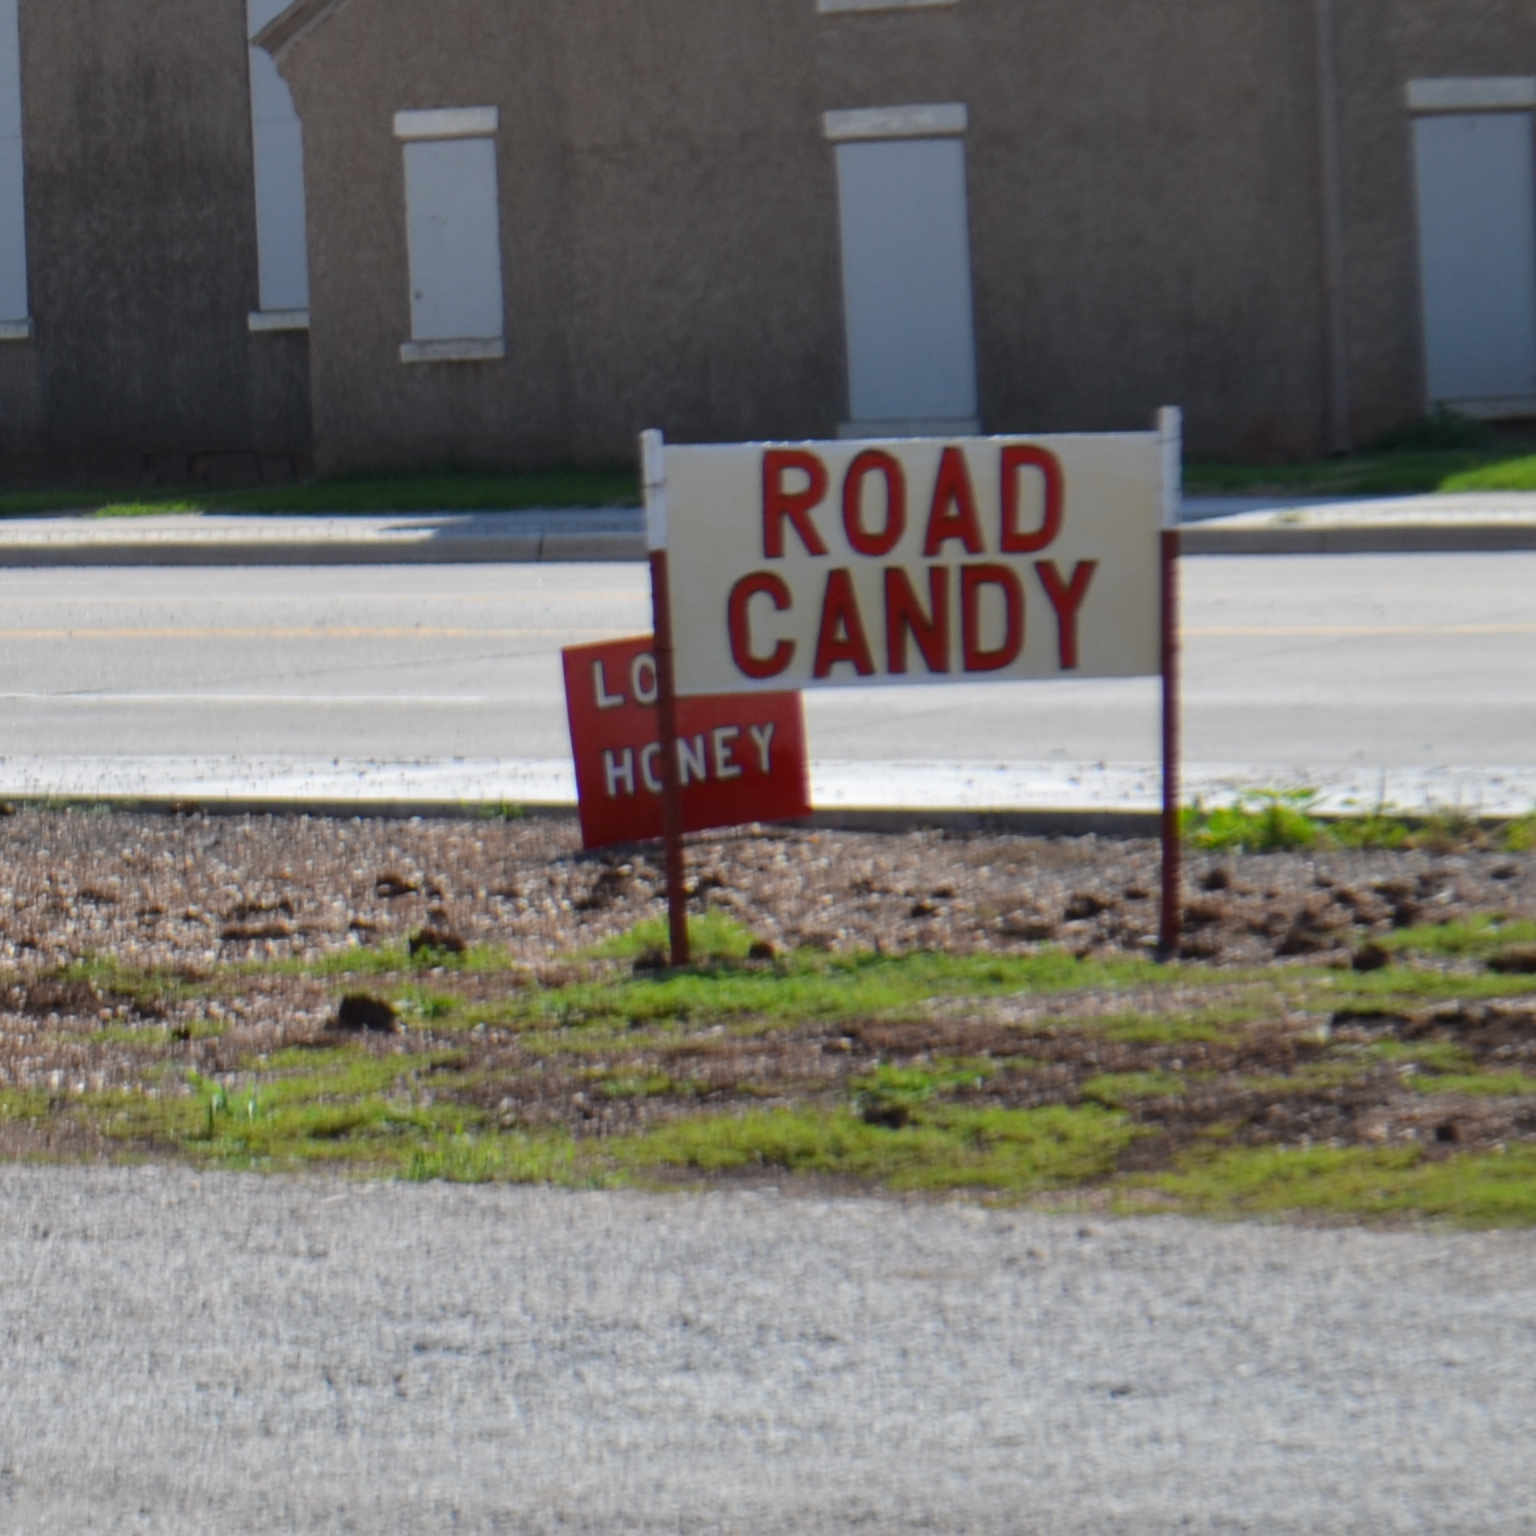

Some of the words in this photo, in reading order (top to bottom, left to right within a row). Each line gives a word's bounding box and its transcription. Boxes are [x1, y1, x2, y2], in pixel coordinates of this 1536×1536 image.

[761, 444, 1065, 558] ROAD
[726, 560, 1099, 679] CANDY
[602, 722, 776, 799] HONEY
